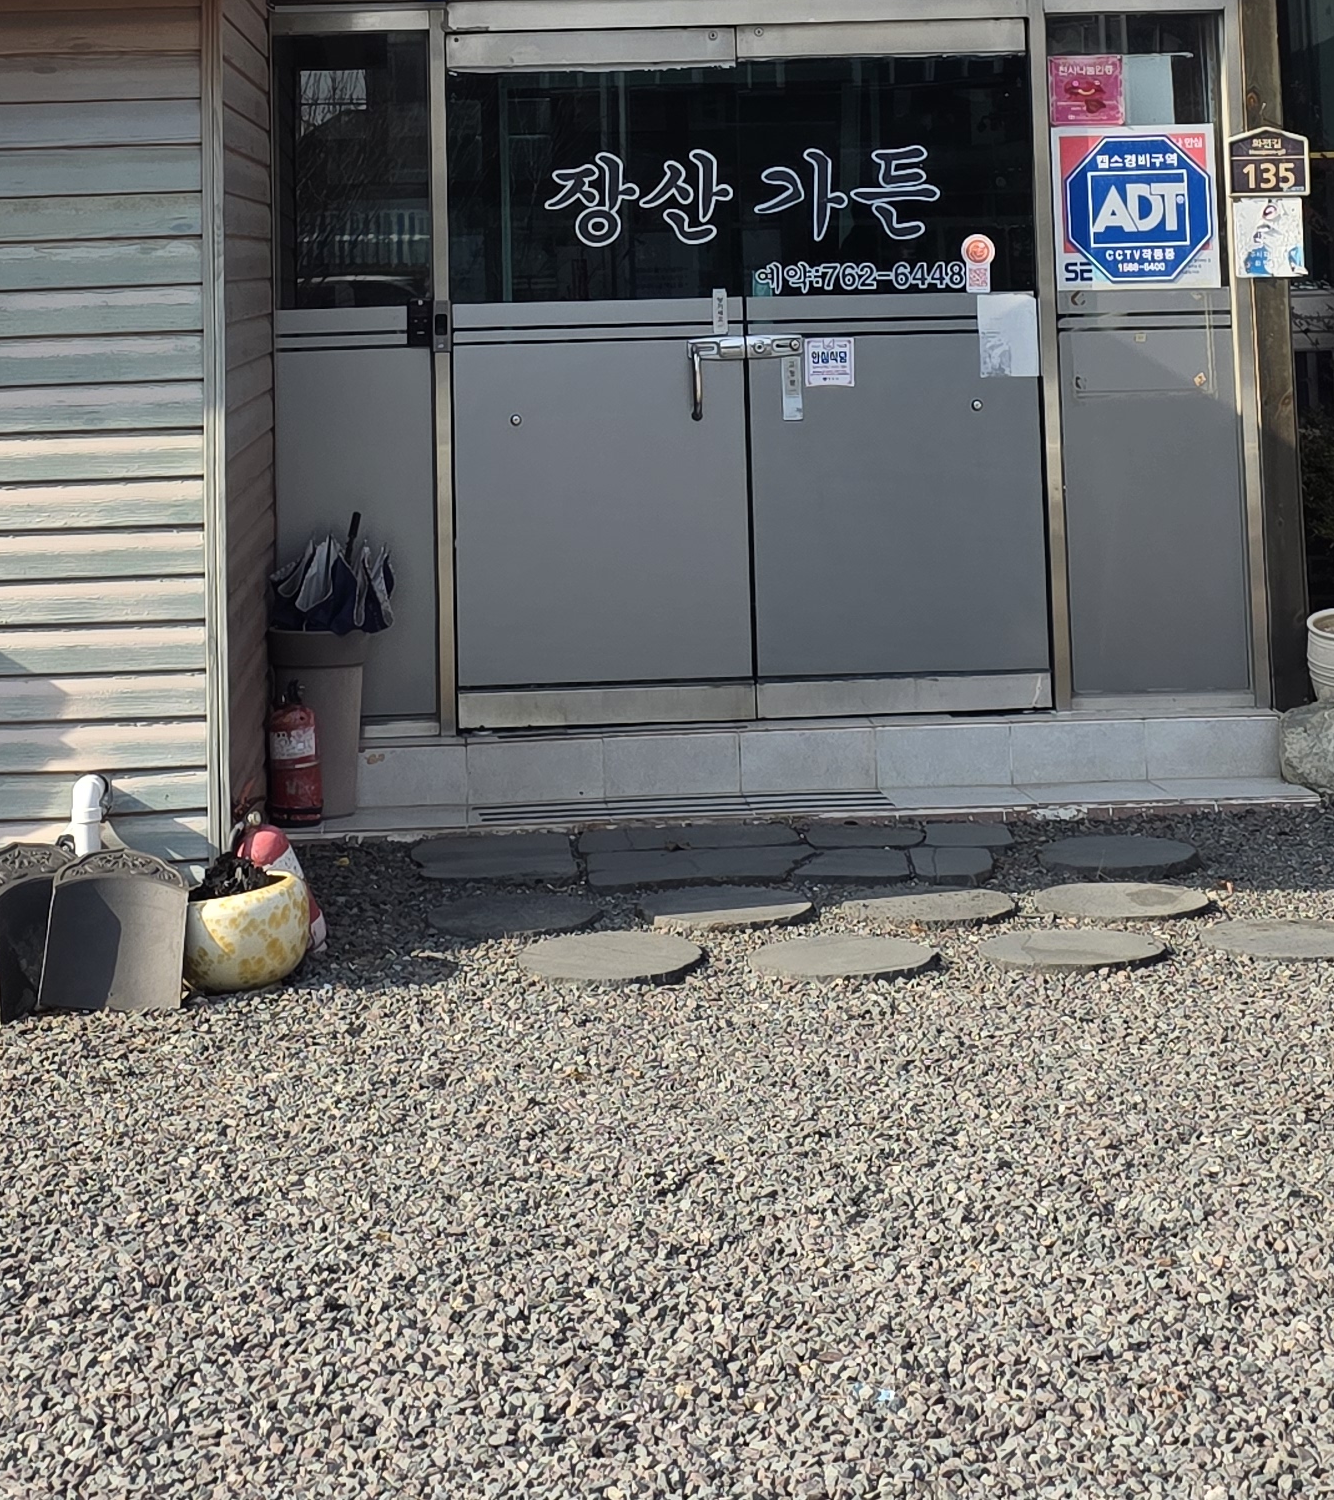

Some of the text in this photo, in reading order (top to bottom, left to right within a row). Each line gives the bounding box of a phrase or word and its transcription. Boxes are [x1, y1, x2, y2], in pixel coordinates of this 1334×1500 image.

[1096, 152, 1178, 169] 캡스경비구역
[1242, 162, 1296, 189] 135
[1093, 182, 1185, 233] ADT
[754, 261, 966, 295] 예약:762-6448
[1064, 261, 1093, 282] SE
